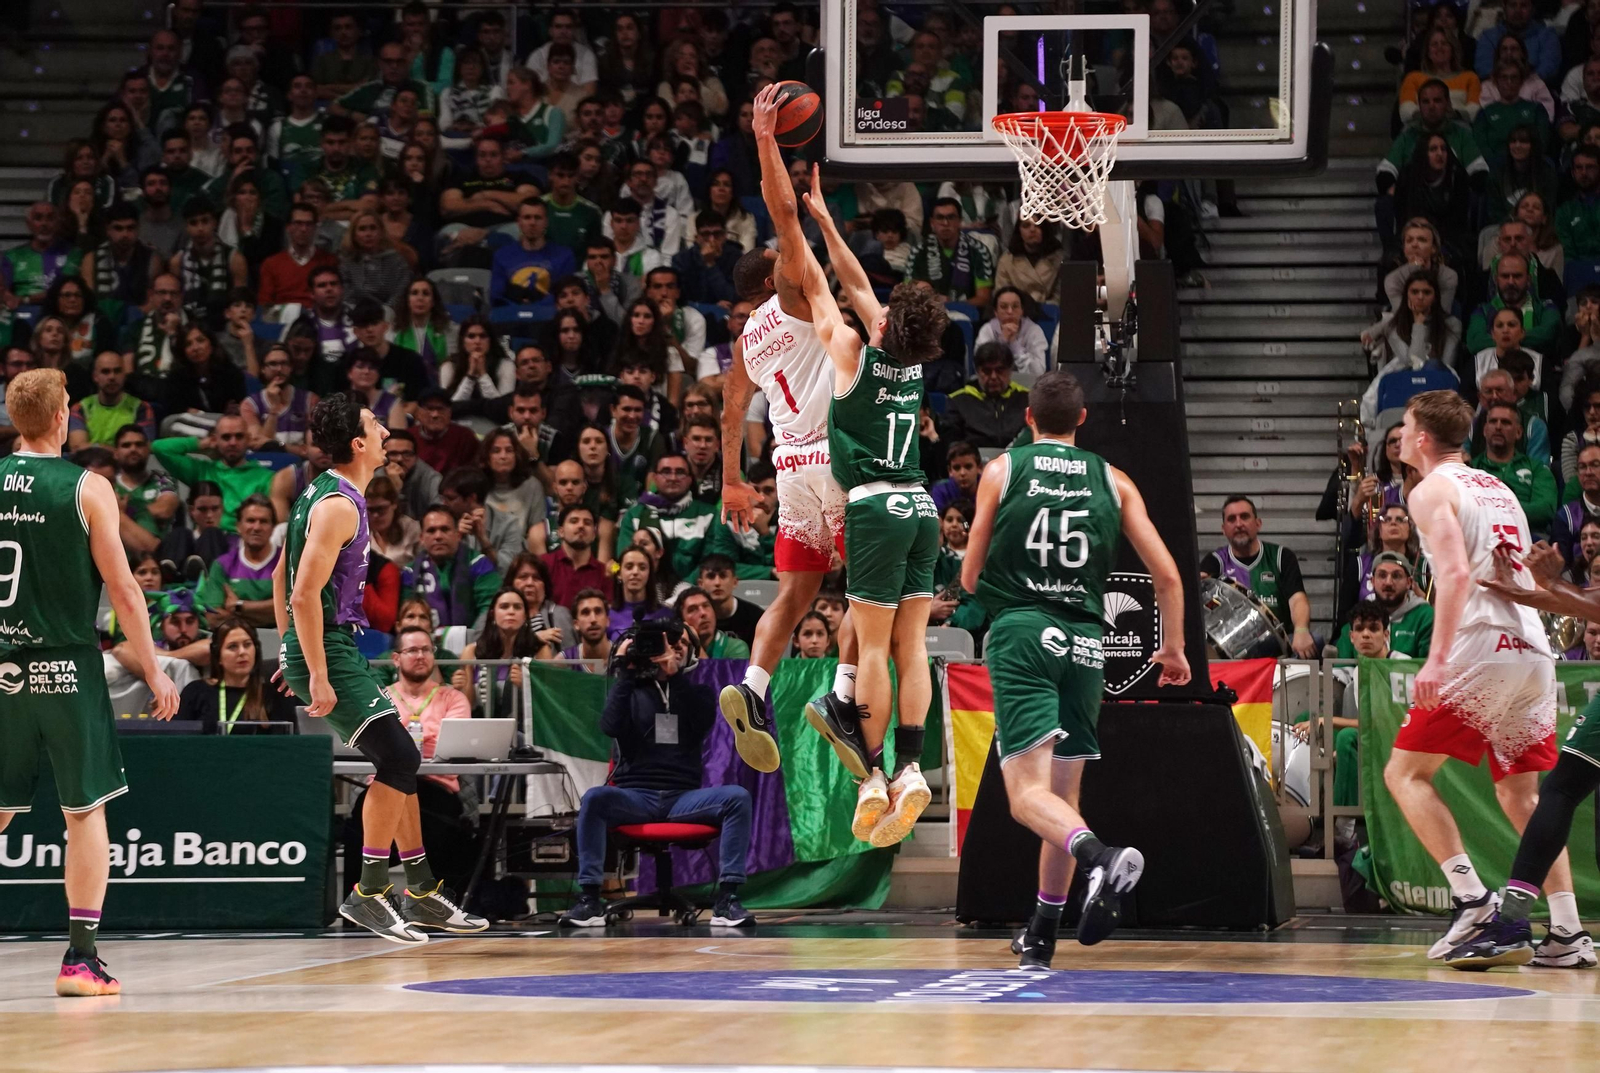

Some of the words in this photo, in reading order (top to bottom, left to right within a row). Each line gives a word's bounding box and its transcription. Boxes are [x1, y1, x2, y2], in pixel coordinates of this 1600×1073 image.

[858, 107, 881, 120] liga
[858, 119, 907, 130] endesa
[774, 369, 800, 414] 1
[886, 412, 916, 464] 17
[1033, 455, 1087, 475] KRAVISH
[3, 471, 35, 493] DÍAZ
[1025, 507, 1090, 569] 45
[1102, 631, 1141, 647] nicaja
[1072, 645, 1093, 658] DEL
[1103, 649, 1142, 658] loncesto
[28, 660, 77, 673] COSTA
[1072, 654, 1104, 670] MÁLAG
[29, 674, 52, 684] DEL
[54, 673, 78, 683] SOL
[30, 683, 79, 694] MÁLAGA
[0, 828, 166, 877] Unaja
[173, 831, 307, 866] Banco
[1389, 880, 1455, 910] Siem
